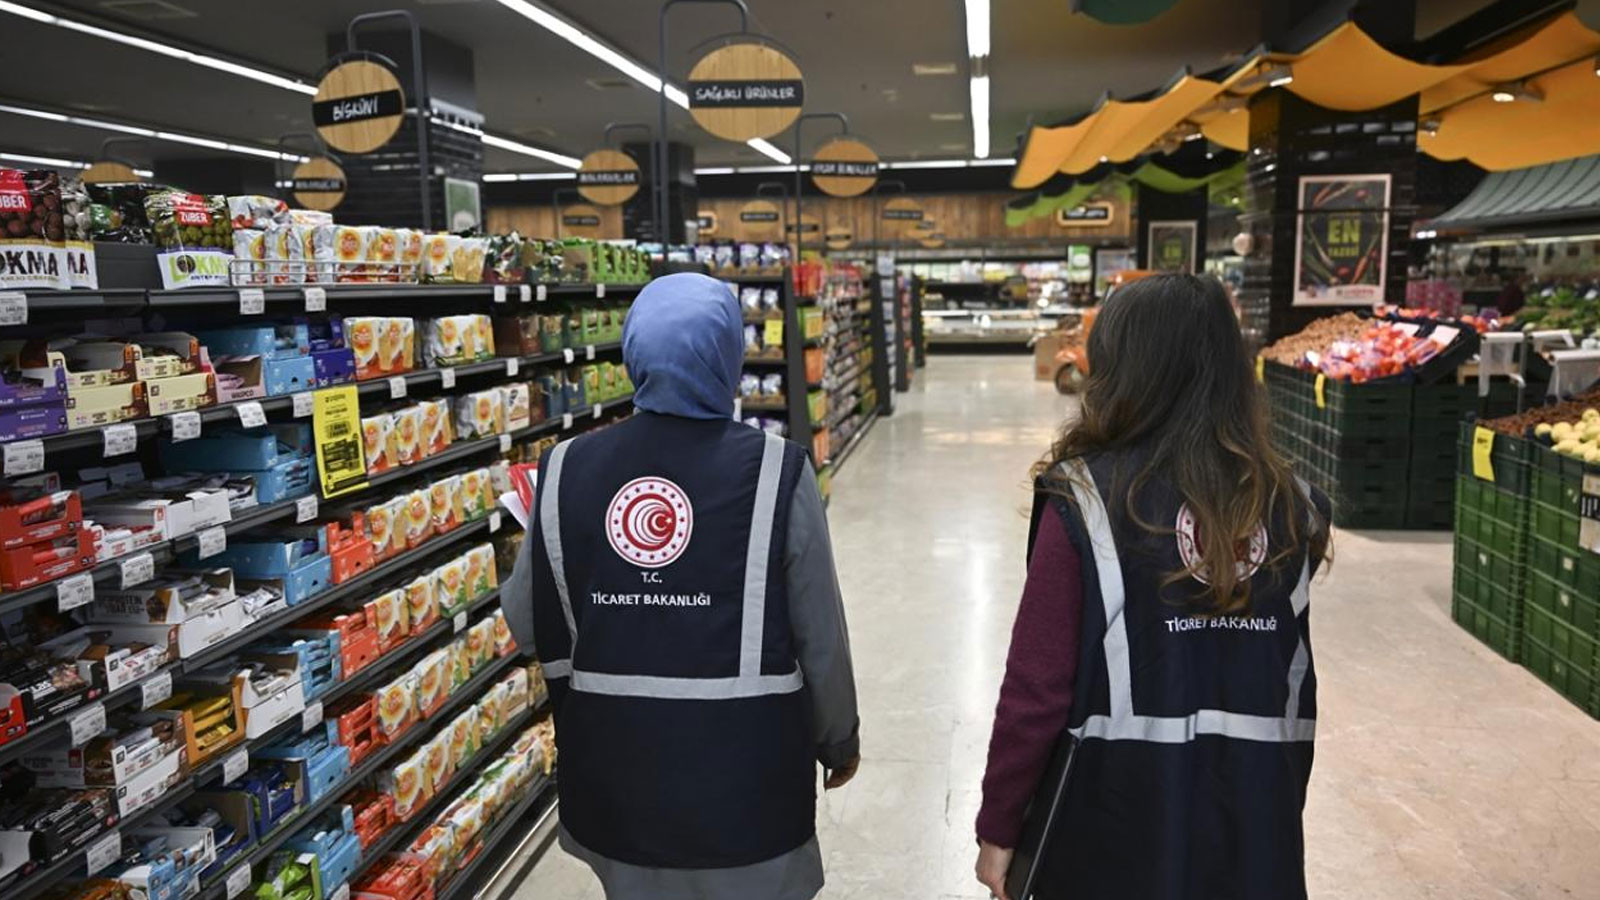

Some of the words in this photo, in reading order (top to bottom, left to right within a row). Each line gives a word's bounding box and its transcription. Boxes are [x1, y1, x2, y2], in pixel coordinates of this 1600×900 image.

[745, 86, 796, 99] ÜRÜNLER
[1328, 219, 1360, 243] EN
[641, 571, 663, 584] T.C.
[590, 591, 640, 605] TİCARET
[643, 592, 711, 607] BAKANLIĞI
